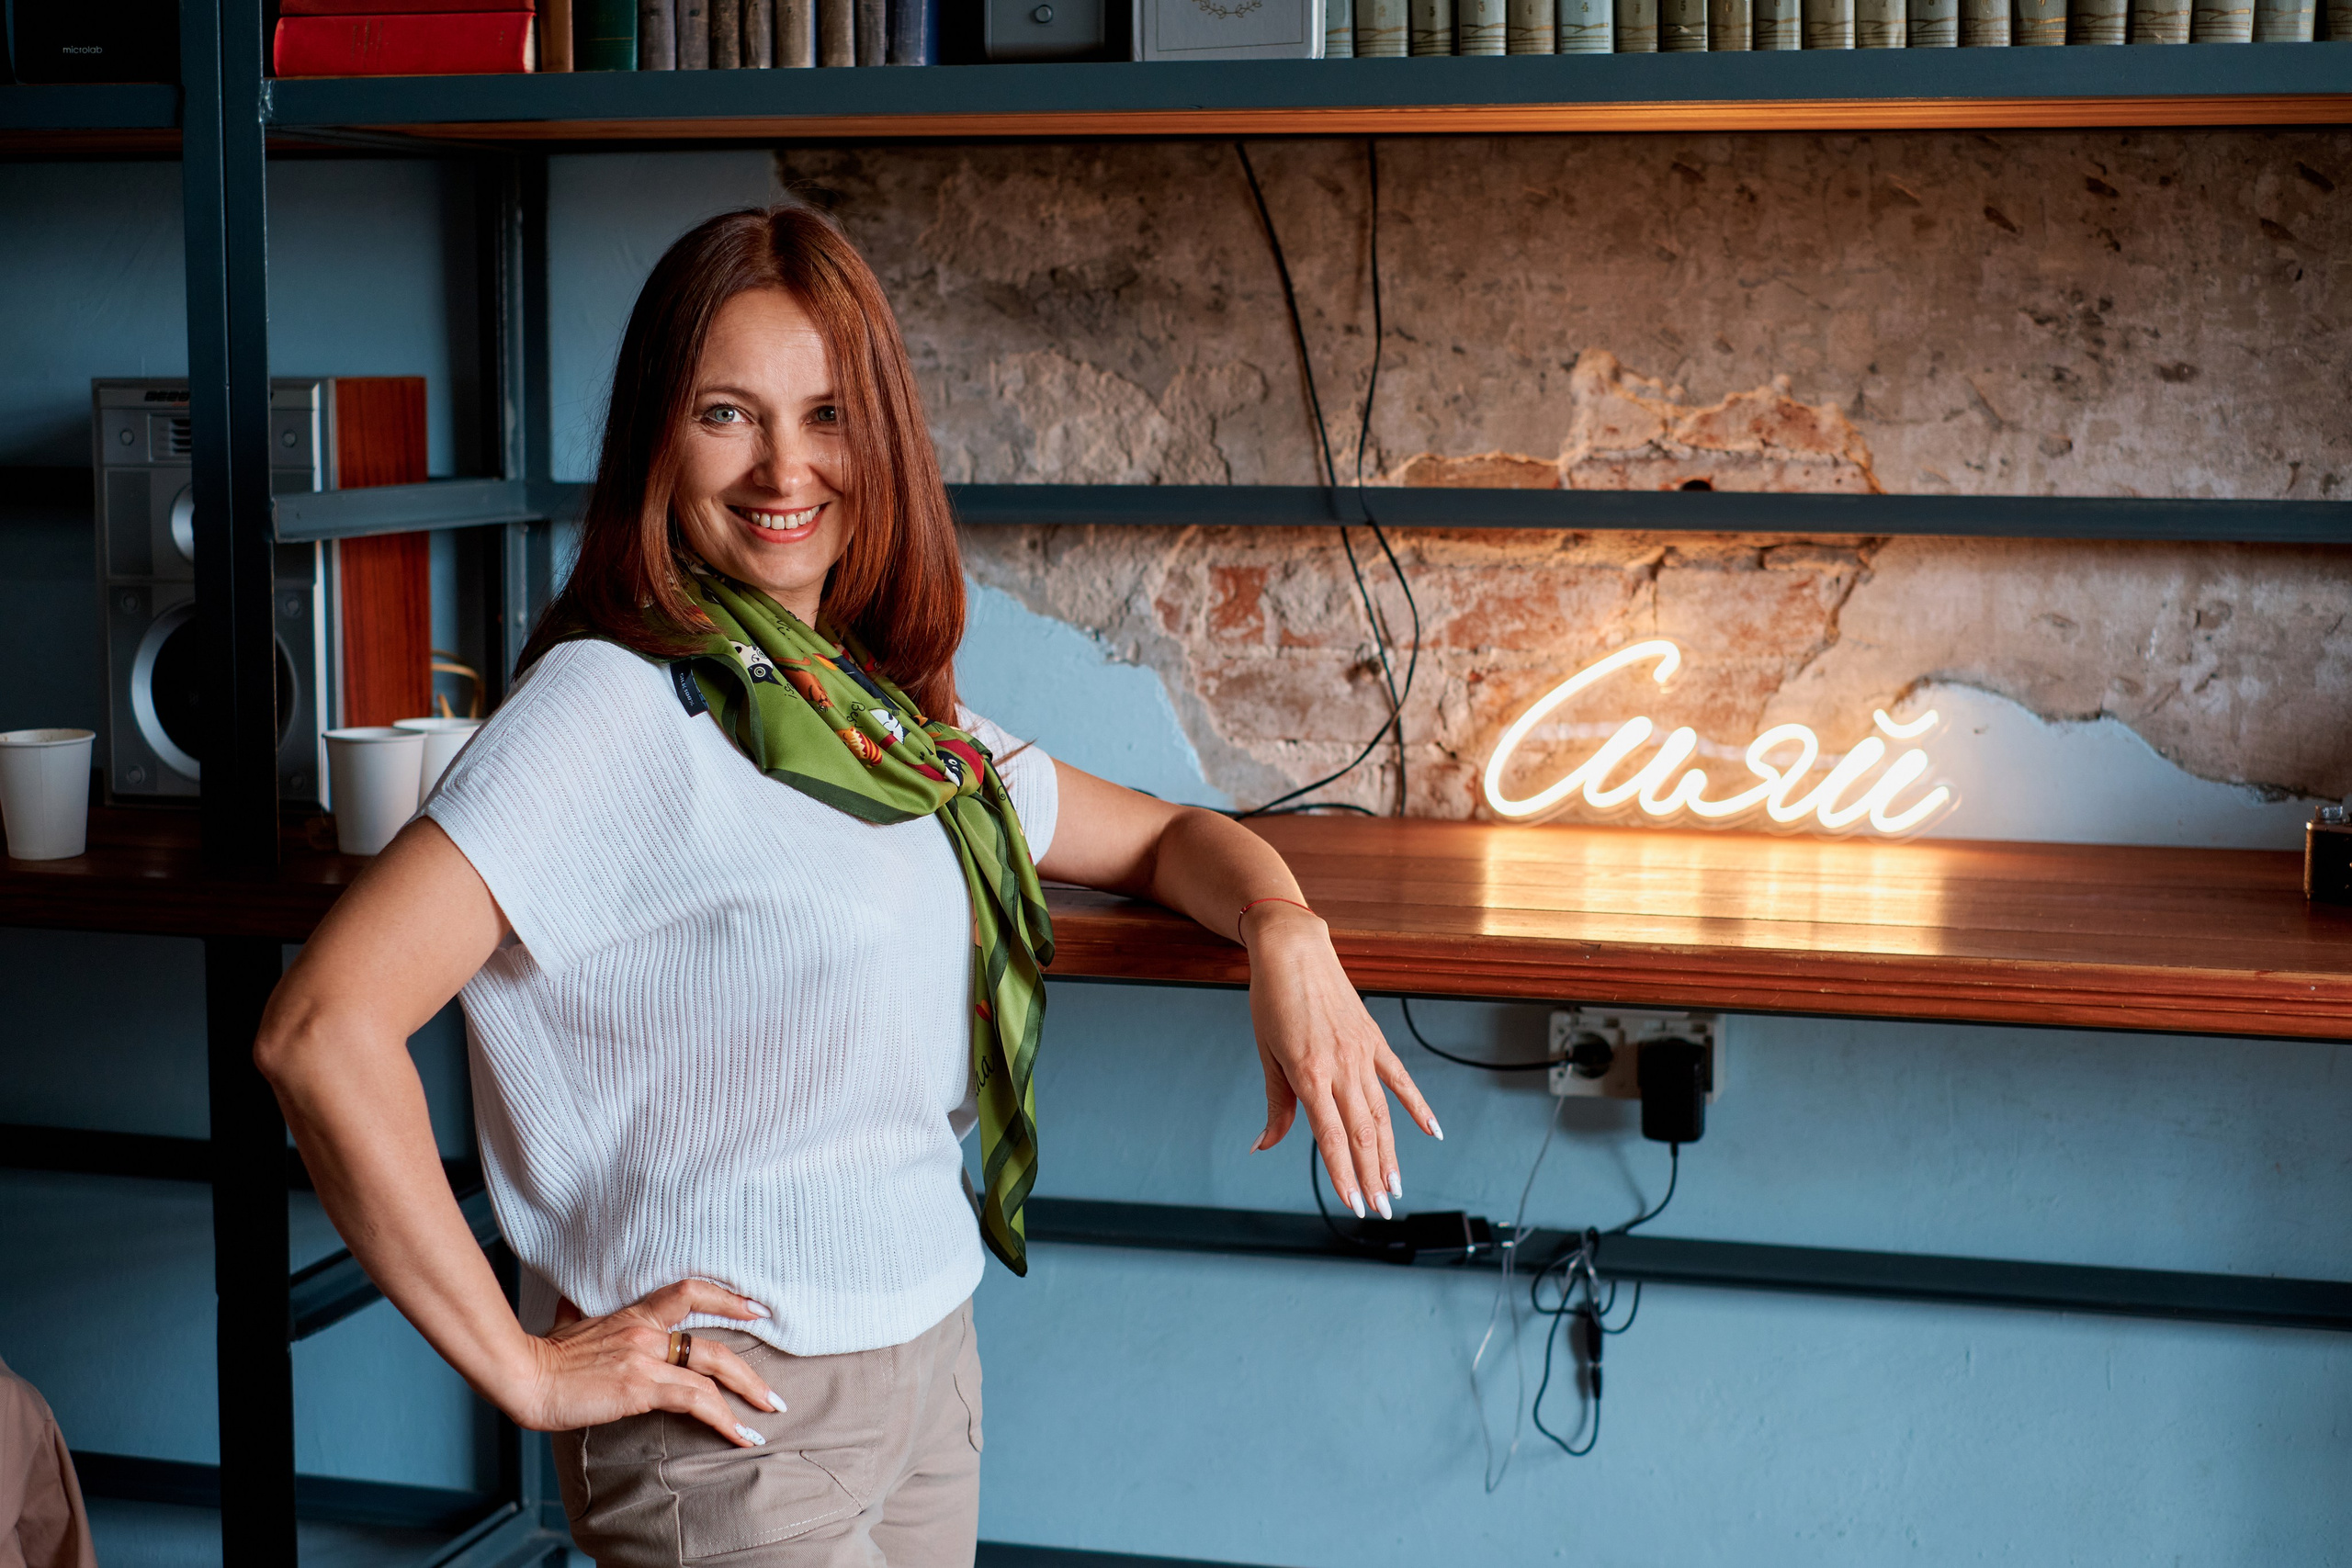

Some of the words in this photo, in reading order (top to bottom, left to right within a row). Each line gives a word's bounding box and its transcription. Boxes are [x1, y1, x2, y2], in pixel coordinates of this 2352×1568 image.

[62, 46, 103, 54] microlab
[679, 672, 687, 689] SILK
[684, 690, 695, 706] 100%
[1484, 639, 1951, 833] Сияй
